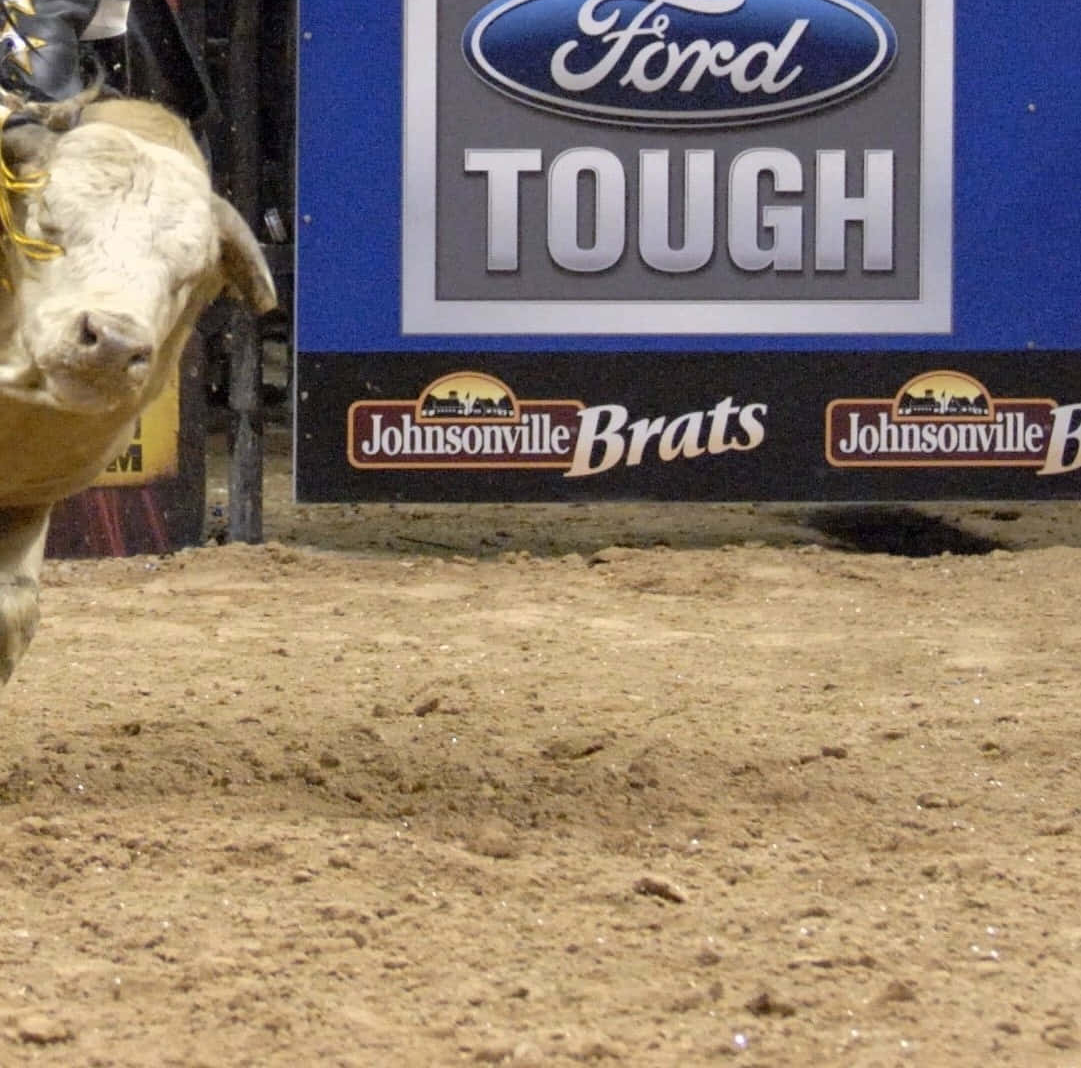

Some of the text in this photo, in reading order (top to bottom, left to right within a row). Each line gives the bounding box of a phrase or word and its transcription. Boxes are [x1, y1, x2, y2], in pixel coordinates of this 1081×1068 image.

[464, 146, 894, 274] TOUGH
[361, 395, 769, 478] Johnsonville Brats
[839, 412, 1044, 455] Johnsonville
